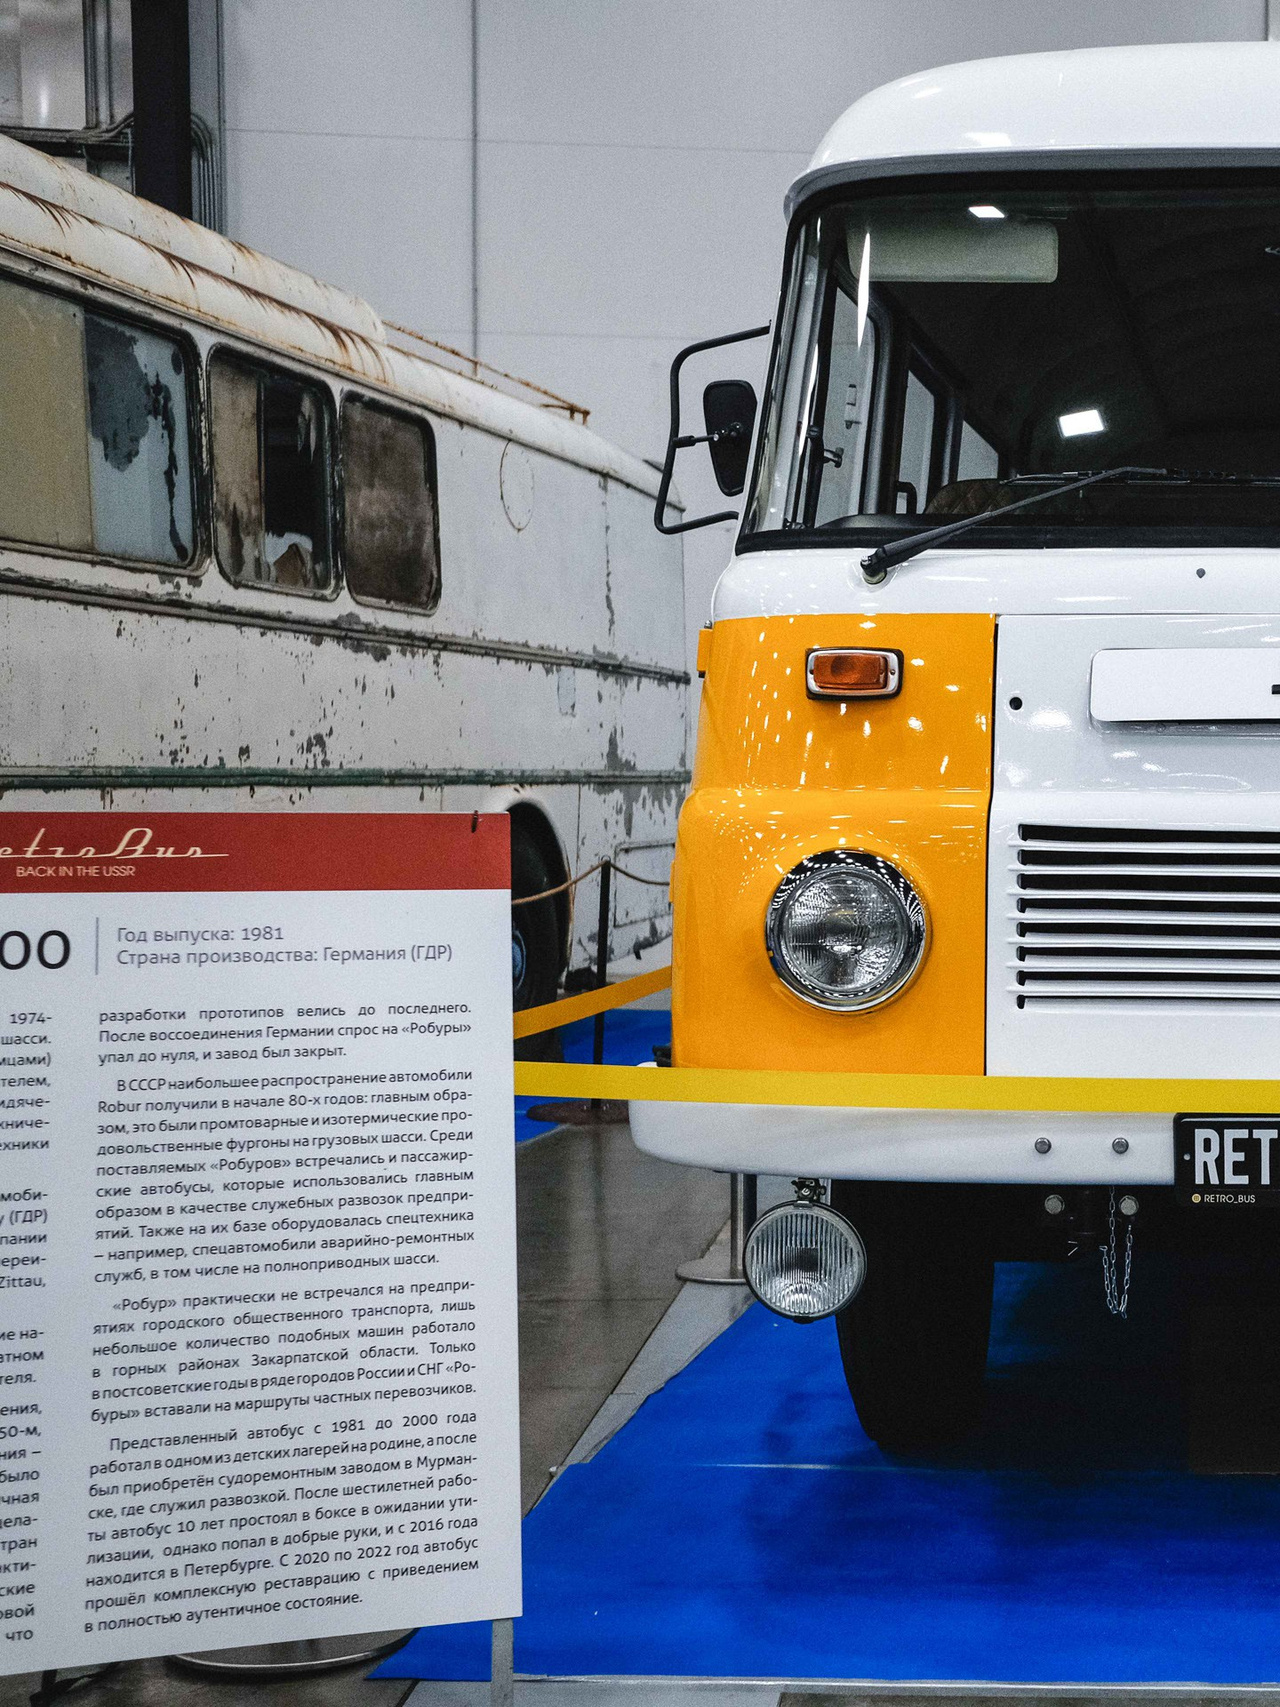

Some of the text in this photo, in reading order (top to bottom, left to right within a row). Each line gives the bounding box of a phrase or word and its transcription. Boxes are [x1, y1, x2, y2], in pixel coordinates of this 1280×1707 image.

[16, 866, 135, 877] BACK IN THE USSR
[118, 926, 283, 945] Год выпуска: 1981
[117, 944, 452, 968] Страна производства: Германия (ГДР)
[11, 1013, 51, 1024] 1974-
[99, 1004, 471, 1025] разработки прототипов велись до последнего.
[1, 1035, 51, 1045] шасси.
[99, 1021, 471, 1042] После воссоединения Германии спрос на «Робуры»
[98, 1045, 346, 1067] упал до нуля, и завод был закрыт.
[98, 1088, 472, 1114] Robur получили в начале 80-х годов: главным обра-
[97, 1111, 472, 1135] зом, это были промтоварные и изотермические про-
[96, 1129, 473, 1156] довольственные фургоны на грузовых шасси. Среди
[96, 1151, 473, 1176] поставляемых «Робуров» встречались и пассажир-
[95, 1171, 473, 1197] ские автобусы, которые использовались главным
[95, 1191, 473, 1221] образом в качестве служебных развозок предпри-
[1204, 1194, 1256, 1204] RETRO_BUS
[10, 1209, 47, 1225] (ГДР)
[95, 1211, 474, 1240] ятий. Также на их базе оборудовалась спецтехника
[107, 1247, 188, 1262] например,
[192, 1238, 316, 1256] спецавтомобили
[320, 1232, 474, 1251] аварийно-ремонтных
[94, 1254, 439, 1285] служб, в том числе на полноприводных шасси.
[112, 1280, 475, 1313] «Робур» практически не встречался на предпри-
[93, 1301, 475, 1334] ятиях городского общественного транспорта, лишь
[20, 1330, 43, 1339] на-
[92, 1320, 475, 1356] небольшое количество подобных машин работало
[92, 1341, 476, 1379] в горных районах Закарпатской области. Только
[90, 1383, 476, 1425] буры» вставали на маршруты частных перевозчиков.
[110, 1412, 476, 1454] Представленный автобус с 1981 до 2000 года
[88, 1454, 477, 1497] был приобретён судоремонтным заводом в Мурман-
[88, 1472, 477, 1519] ске, где служил развозкой. После шестилетней рабо-
[85, 1560, 479, 1613] прошёл комплексную реставрацию с приведением
[84, 1593, 362, 1633] в полностью аутентичное состояние.
[6, 1630, 33, 1641] что
